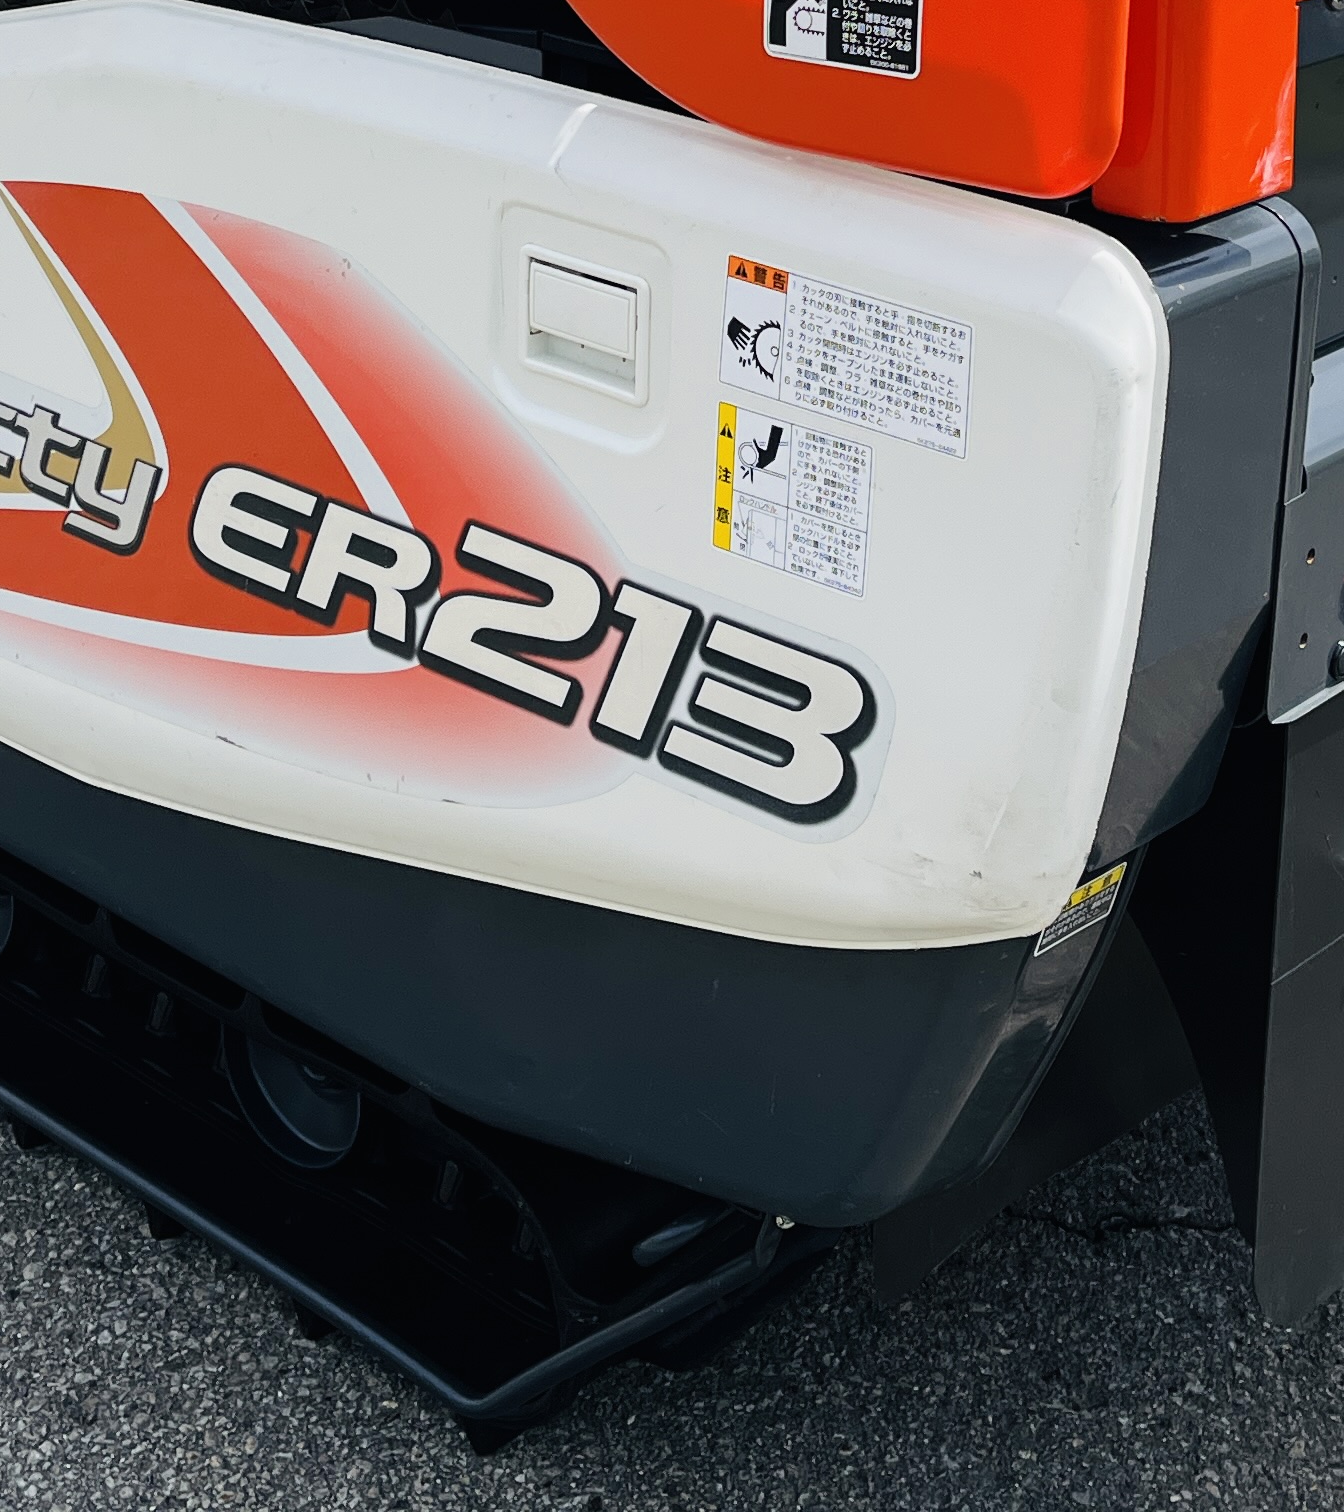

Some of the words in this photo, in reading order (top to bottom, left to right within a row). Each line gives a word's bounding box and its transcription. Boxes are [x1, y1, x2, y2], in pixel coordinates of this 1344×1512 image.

[753, 265, 786, 291] 警告
[716, 465, 732, 524] 注意
[188, 463, 877, 825] ER213
